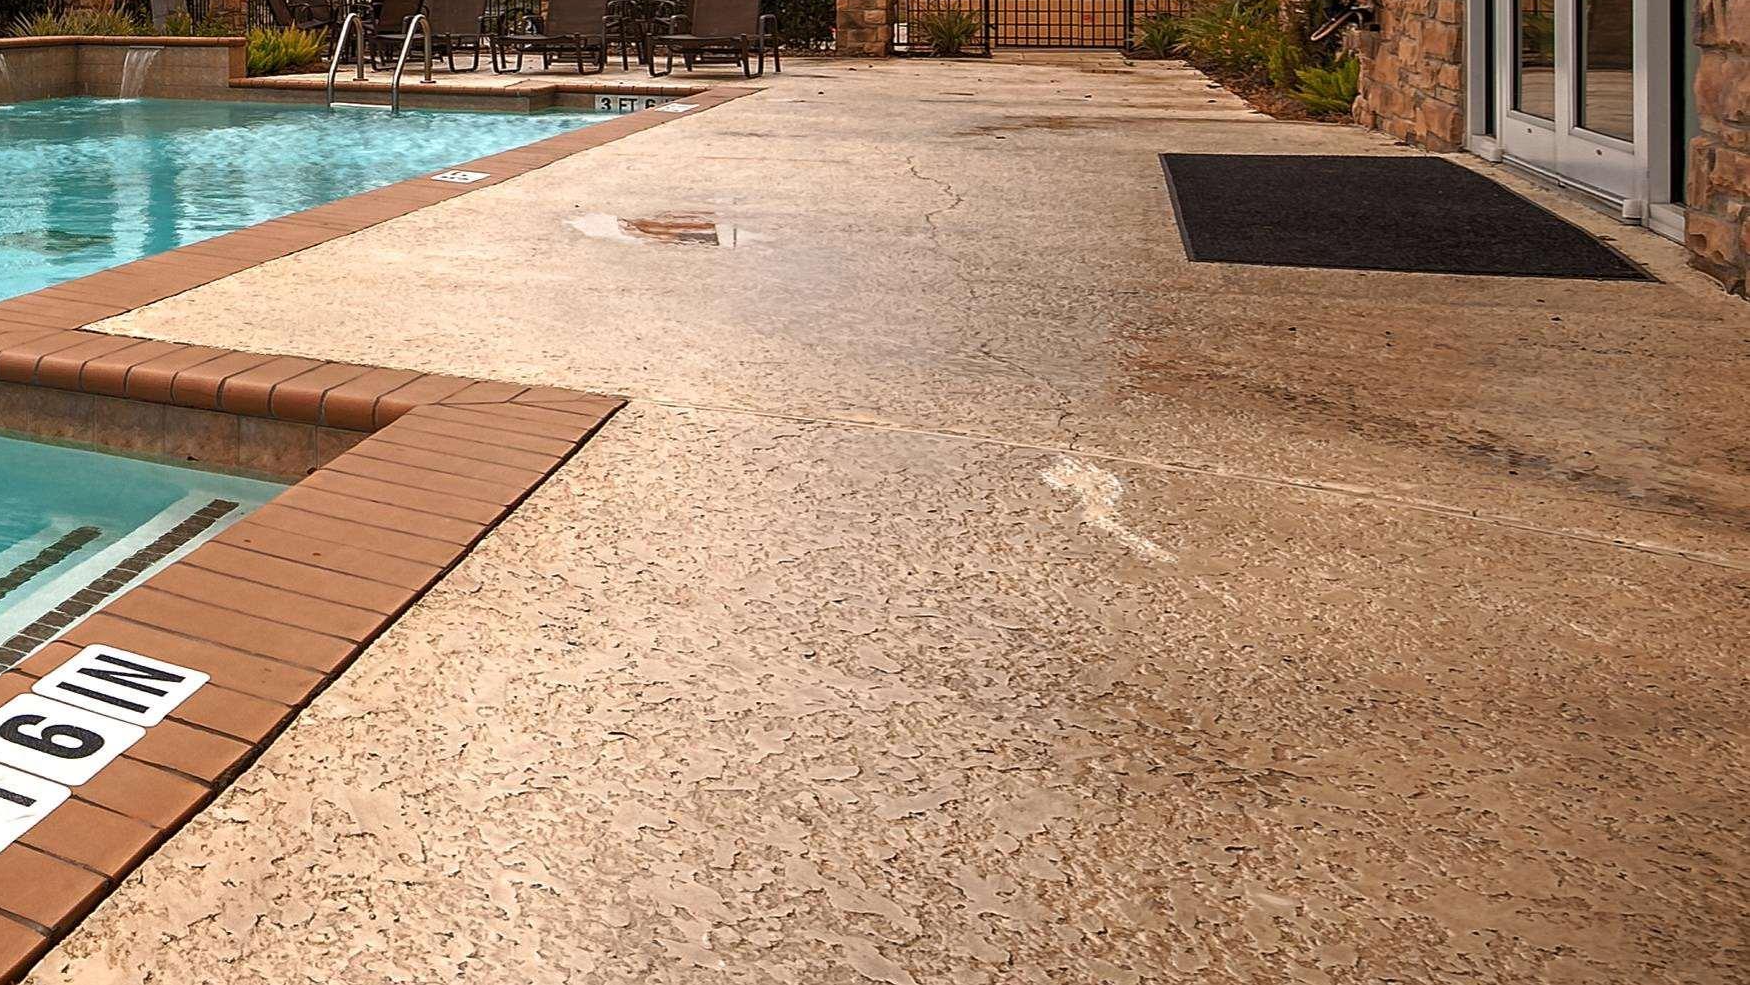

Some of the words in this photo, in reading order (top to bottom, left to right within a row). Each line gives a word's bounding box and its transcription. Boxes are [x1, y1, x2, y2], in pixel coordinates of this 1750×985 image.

[600, 97, 611, 111] 3
[618, 97, 638, 113] FT
[56, 653, 187, 714] IN
